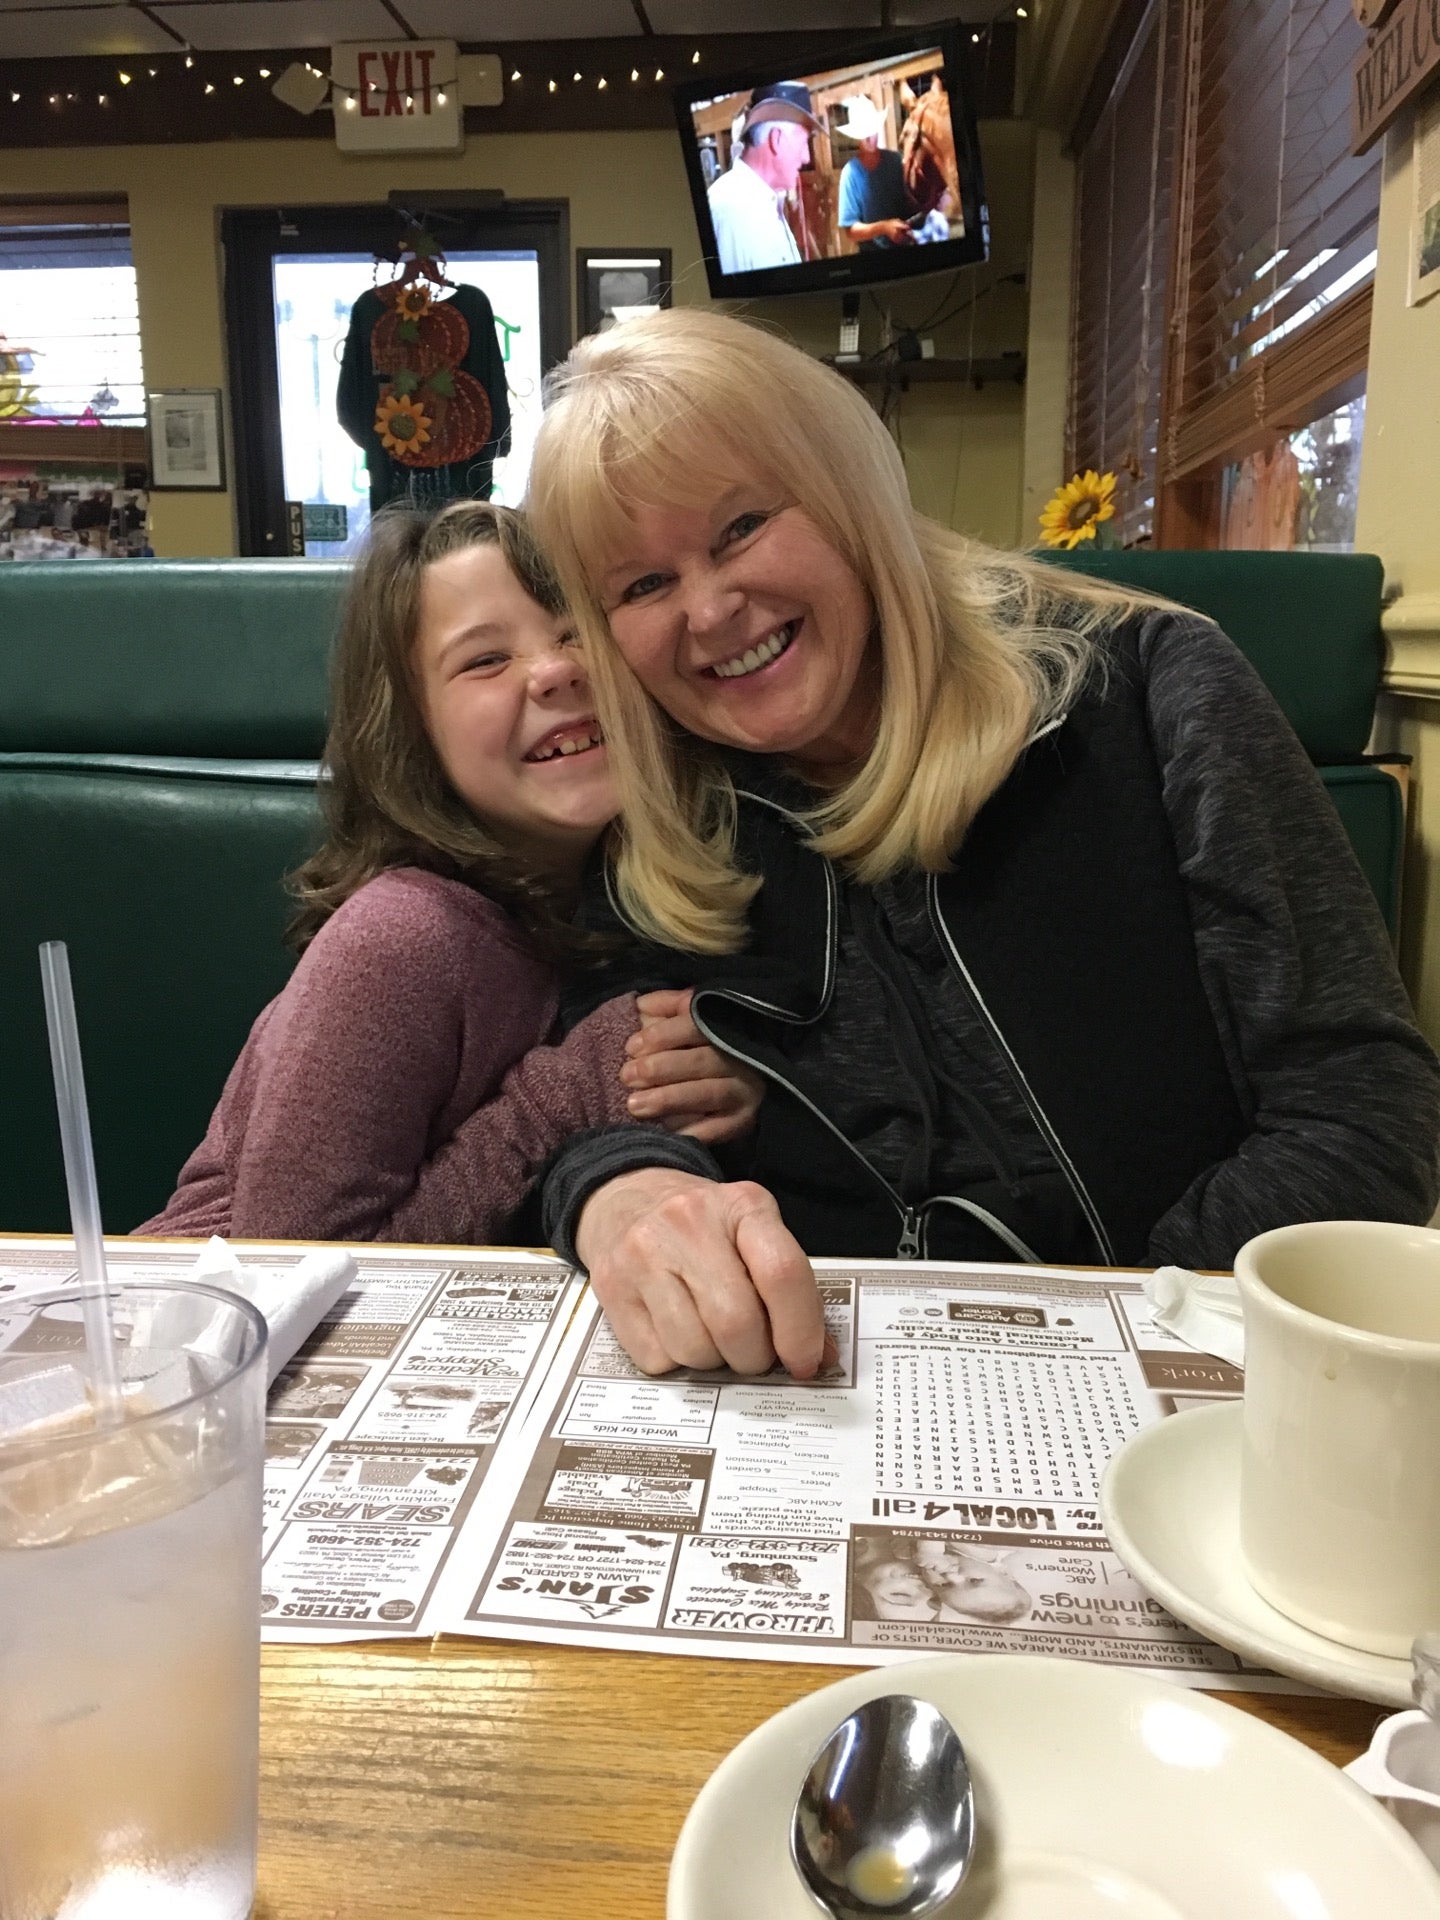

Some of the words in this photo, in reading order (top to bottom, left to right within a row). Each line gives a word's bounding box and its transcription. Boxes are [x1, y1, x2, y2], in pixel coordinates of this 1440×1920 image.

[358, 49, 435, 117] EXIT
[954, 1312, 1011, 1322] AutoCare
[960, 1308, 1002, 1316] Center
[885, 1324, 944, 1332] Facility
[948, 1328, 1000, 1337] Repair
[920, 1332, 960, 1340] Body
[965, 1335, 1002, 1344] Auto
[1005, 1332, 1094, 1343] Mechanical
[920, 1344, 952, 1352] Word
[994, 1349, 1057, 1359] Neighbors
[426, 1356, 505, 1368] Shoppe
[402, 1364, 511, 1377] Medicine
[1161, 1367, 1225, 1382] Pork
[592, 1424, 619, 1434] Kids
[620, 1426, 638, 1435] for
[794, 1422, 834, 1430] Thrower
[353, 1433, 407, 1442] Landscape
[640, 1427, 678, 1438] Words
[409, 1435, 445, 1443] Becken
[738, 1440, 791, 1448] Appliances
[724, 1456, 788, 1466] Transmission
[793, 1452, 830, 1460] Becken
[557, 1471, 613, 1482] Available!
[566, 1479, 599, 1488] Deals
[800, 1479, 831, 1487] Peters
[333, 1484, 353, 1493] PA
[557, 1486, 603, 1496] Package
[738, 1485, 778, 1494] Shoppe
[302, 1491, 337, 1500] Mall
[339, 1492, 391, 1502] Village
[393, 1494, 457, 1504] Franklin
[716, 1494, 740, 1502] Care
[786, 1498, 809, 1506] ABC
[810, 1499, 843, 1507] ACMH
[292, 1500, 451, 1524] SEARS
[745, 1512, 788, 1520] finding
[1066, 1508, 1097, 1520] by:
[558, 1514, 615, 1526] Inspection
[617, 1520, 651, 1529] Home
[565, 1527, 598, 1536] Please
[724, 1524, 762, 1532] words
[764, 1526, 811, 1534] missing
[814, 1528, 841, 1536] Find
[306, 1534, 422, 1548] 724-352-4608
[564, 1532, 607, 1542] Seasonal
[951, 1532, 982, 1541] (724)
[1029, 1538, 1062, 1546] Drive
[1065, 1540, 1093, 1548] Pike
[710, 1550, 731, 1558] PA
[1058, 1557, 1093, 1566] Care
[521, 1567, 580, 1578] GARDEN
[1025, 1562, 1095, 1575] Women's
[583, 1571, 594, 1579] &
[596, 1572, 640, 1582] LAWN
[1064, 1574, 1096, 1584] ABC
[689, 1585, 749, 1597] Supplies
[754, 1588, 813, 1600] Building
[686, 1596, 743, 1607] Concrete
[748, 1598, 779, 1610] Mix
[784, 1601, 830, 1612] Ready
[1039, 1592, 1165, 1616] ginnings
[279, 1603, 372, 1620] PETERS
[671, 1608, 835, 1635] THROWER
[1030, 1609, 1093, 1627] new
[1099, 1615, 1121, 1626] to
[877, 1624, 1003, 1638] www.local4all.com
[871, 1633, 890, 1642] OF
[892, 1634, 929, 1643] LISTS
[932, 1636, 982, 1647] COVER,
[1065, 1638, 1096, 1646] AND
[985, 1640, 1008, 1649] WE
[1010, 1642, 1055, 1653] AREAS
[1100, 1640, 1202, 1655] RESTAURANTS,
[1058, 1646, 1087, 1656] FOR
[1090, 1649, 1151, 1661] WEBSITE
[1153, 1654, 1184, 1664] OUR
[1190, 1657, 1213, 1666] SEE
